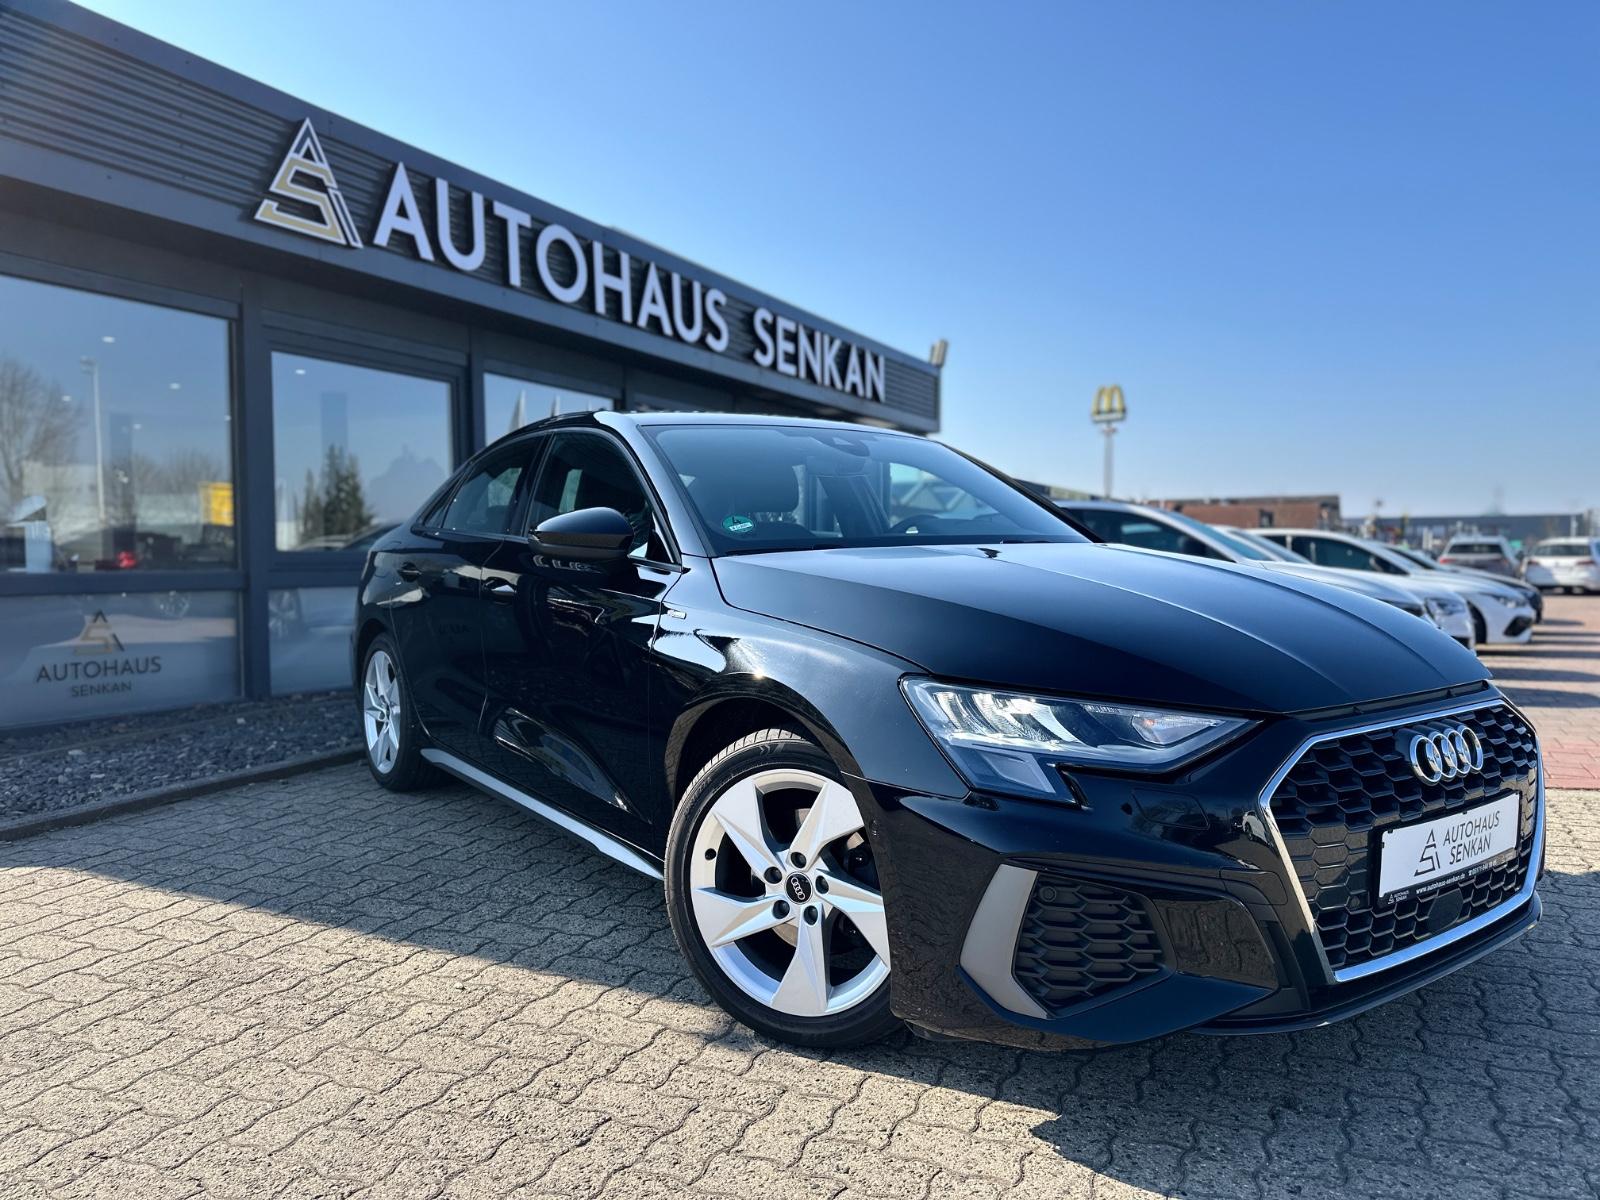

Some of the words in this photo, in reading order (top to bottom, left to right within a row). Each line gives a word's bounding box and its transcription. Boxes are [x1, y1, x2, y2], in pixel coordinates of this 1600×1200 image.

[373, 161, 728, 353] AUTOHAUS
[753, 308, 885, 402] SENKAN
[36, 656, 162, 683] AUTOHAUS
[71, 681, 132, 698] SENKAN
[1443, 811, 1499, 846] AUTOHAUS
[1449, 833, 1492, 865] SENKAN
